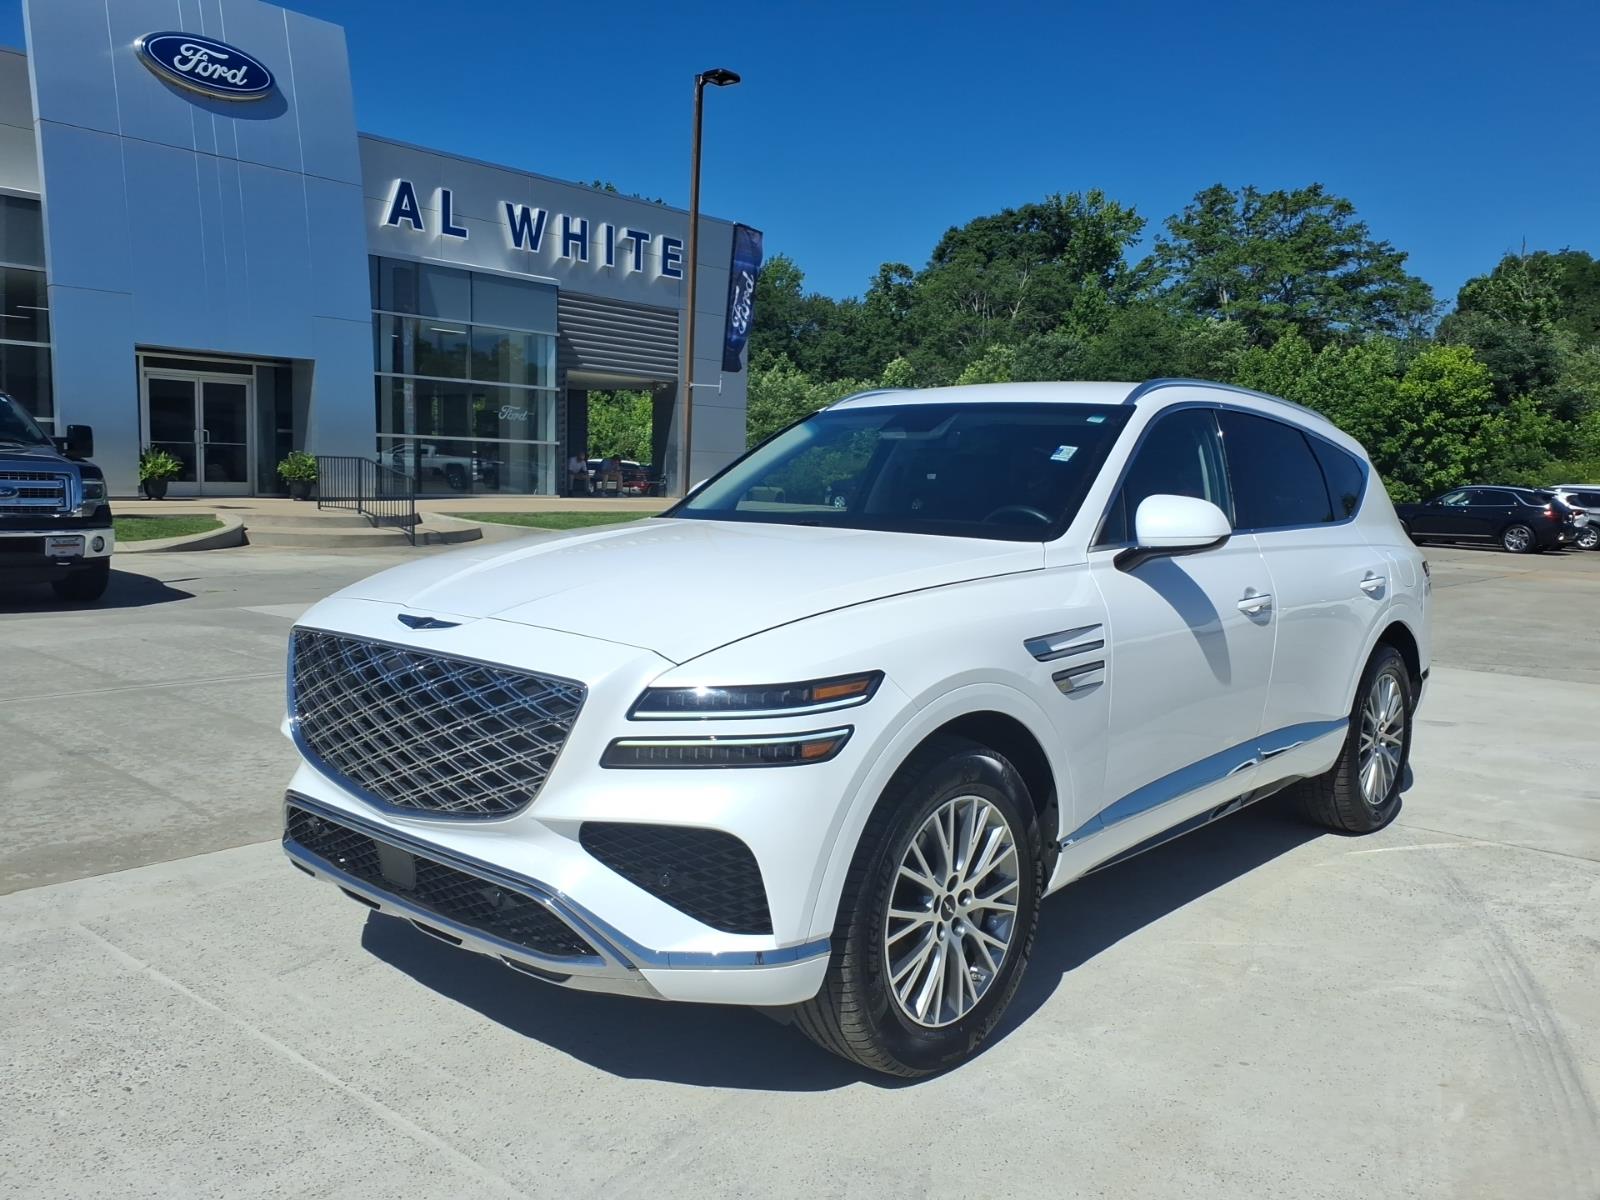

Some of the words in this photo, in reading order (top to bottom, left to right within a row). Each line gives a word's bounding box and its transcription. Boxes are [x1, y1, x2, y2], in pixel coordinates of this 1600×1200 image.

[173, 42, 249, 87] Ford
[384, 178, 469, 240] AL
[504, 201, 684, 280] WHITE
[732, 270, 755, 335] Ford
[498, 404, 528, 421] Ford
